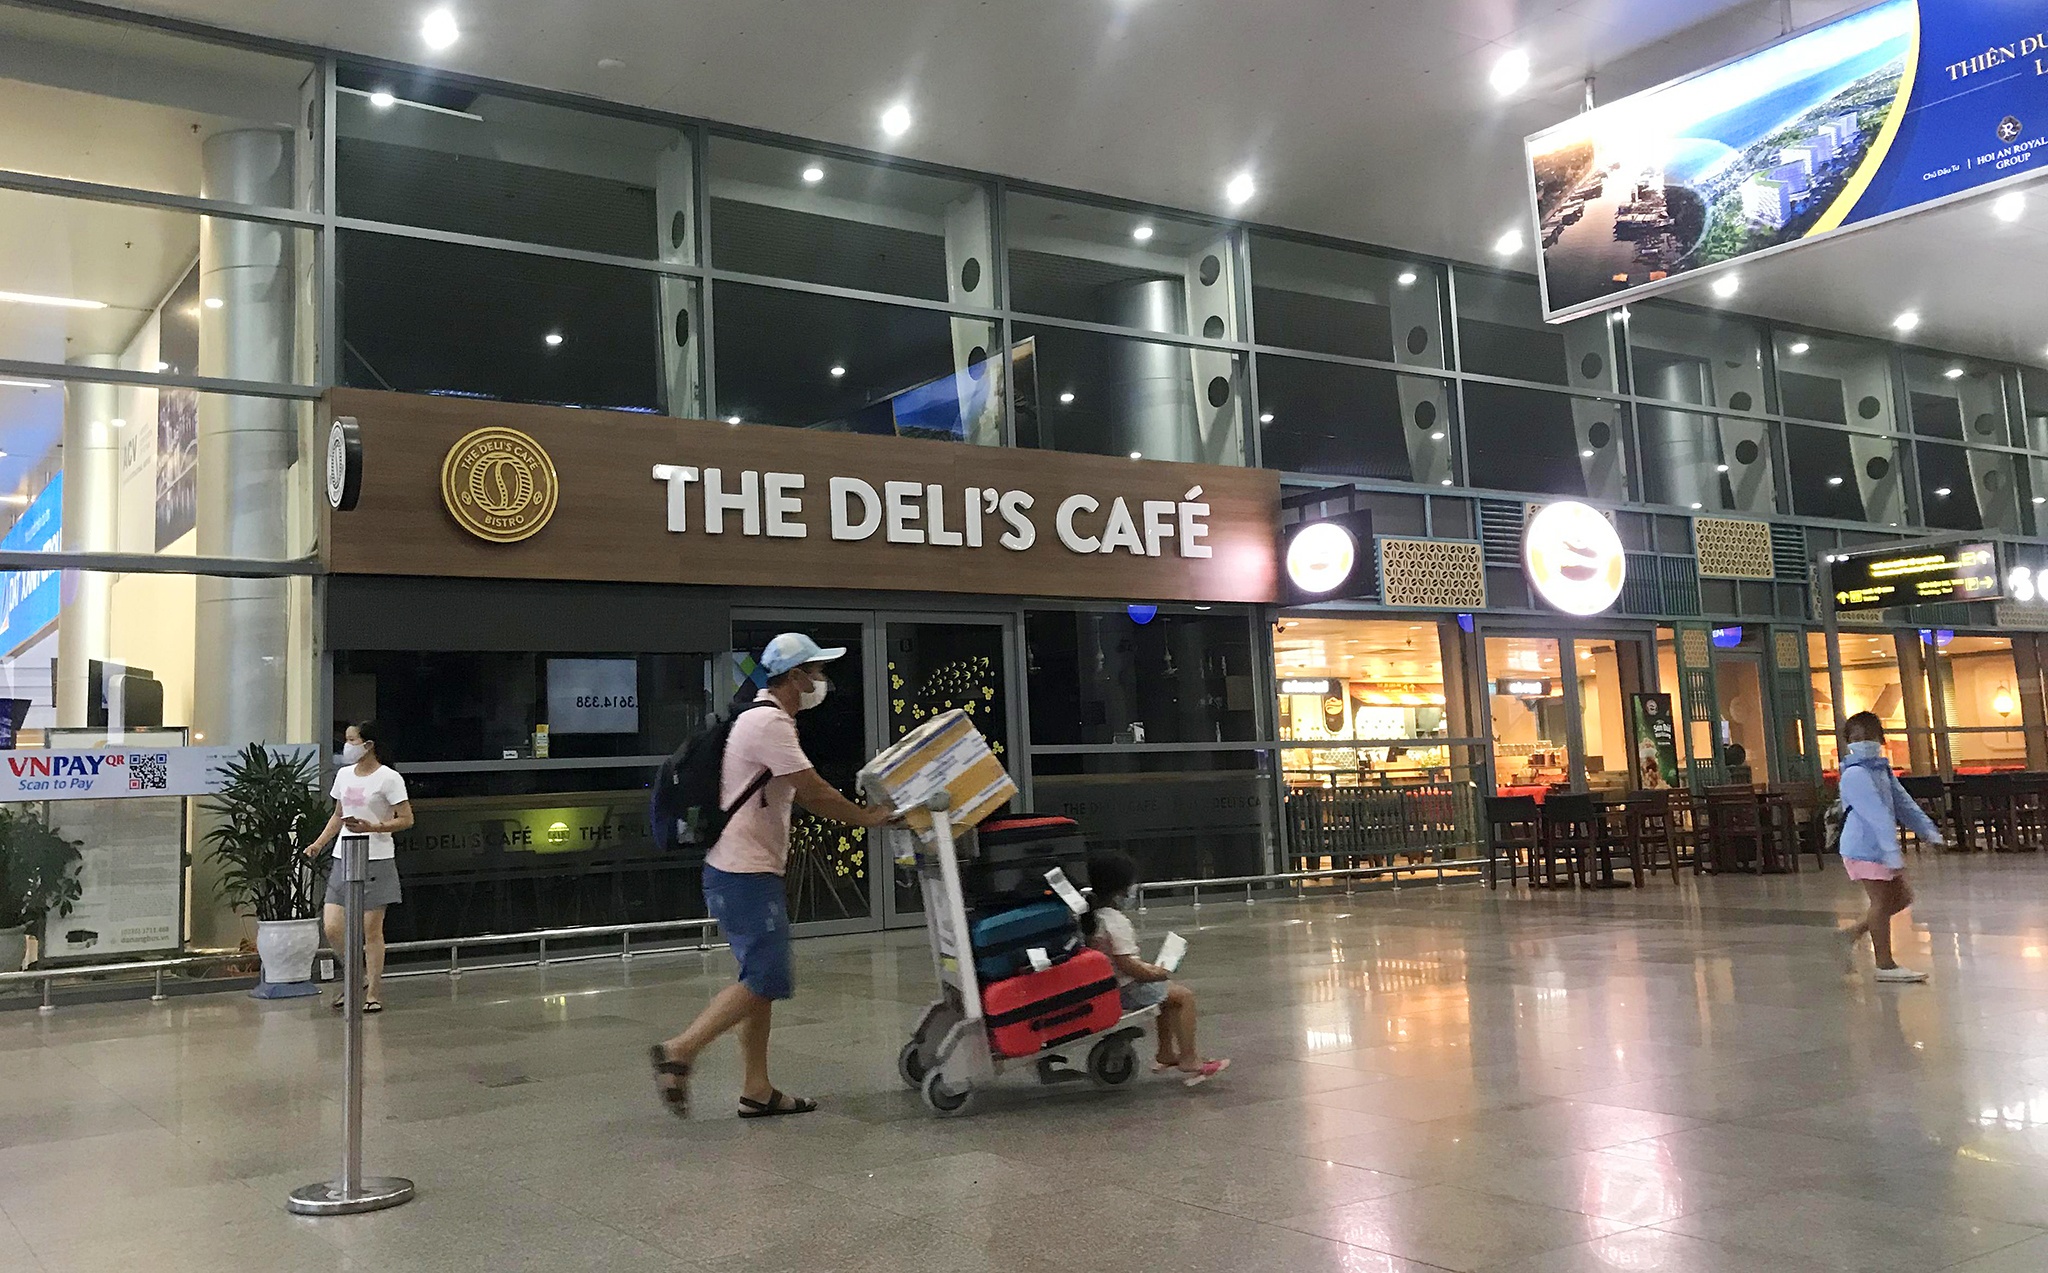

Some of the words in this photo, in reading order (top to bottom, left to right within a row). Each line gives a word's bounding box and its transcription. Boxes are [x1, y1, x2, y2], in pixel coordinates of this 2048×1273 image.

[1945, 43, 2016, 81] THIÊN
[1977, 152, 1996, 166] HOI
[1997, 146, 2012, 160] AN
[2013, 136, 2048, 154] ROYAL
[1995, 151, 2031, 170] GROUP
[461, 449, 480, 471] THE
[479, 440, 513, 455] DELI'S
[484, 514, 525, 528] BISTRO
[652, 463, 808, 538] THE
[829, 476, 1036, 551] DELI'S
[1055, 485, 1213, 558] CAFÉ
[18, 779, 49, 791] Scan
[53, 779, 67, 790] to
[70, 777, 94, 791] Pay
[578, 825, 613, 842] THE
